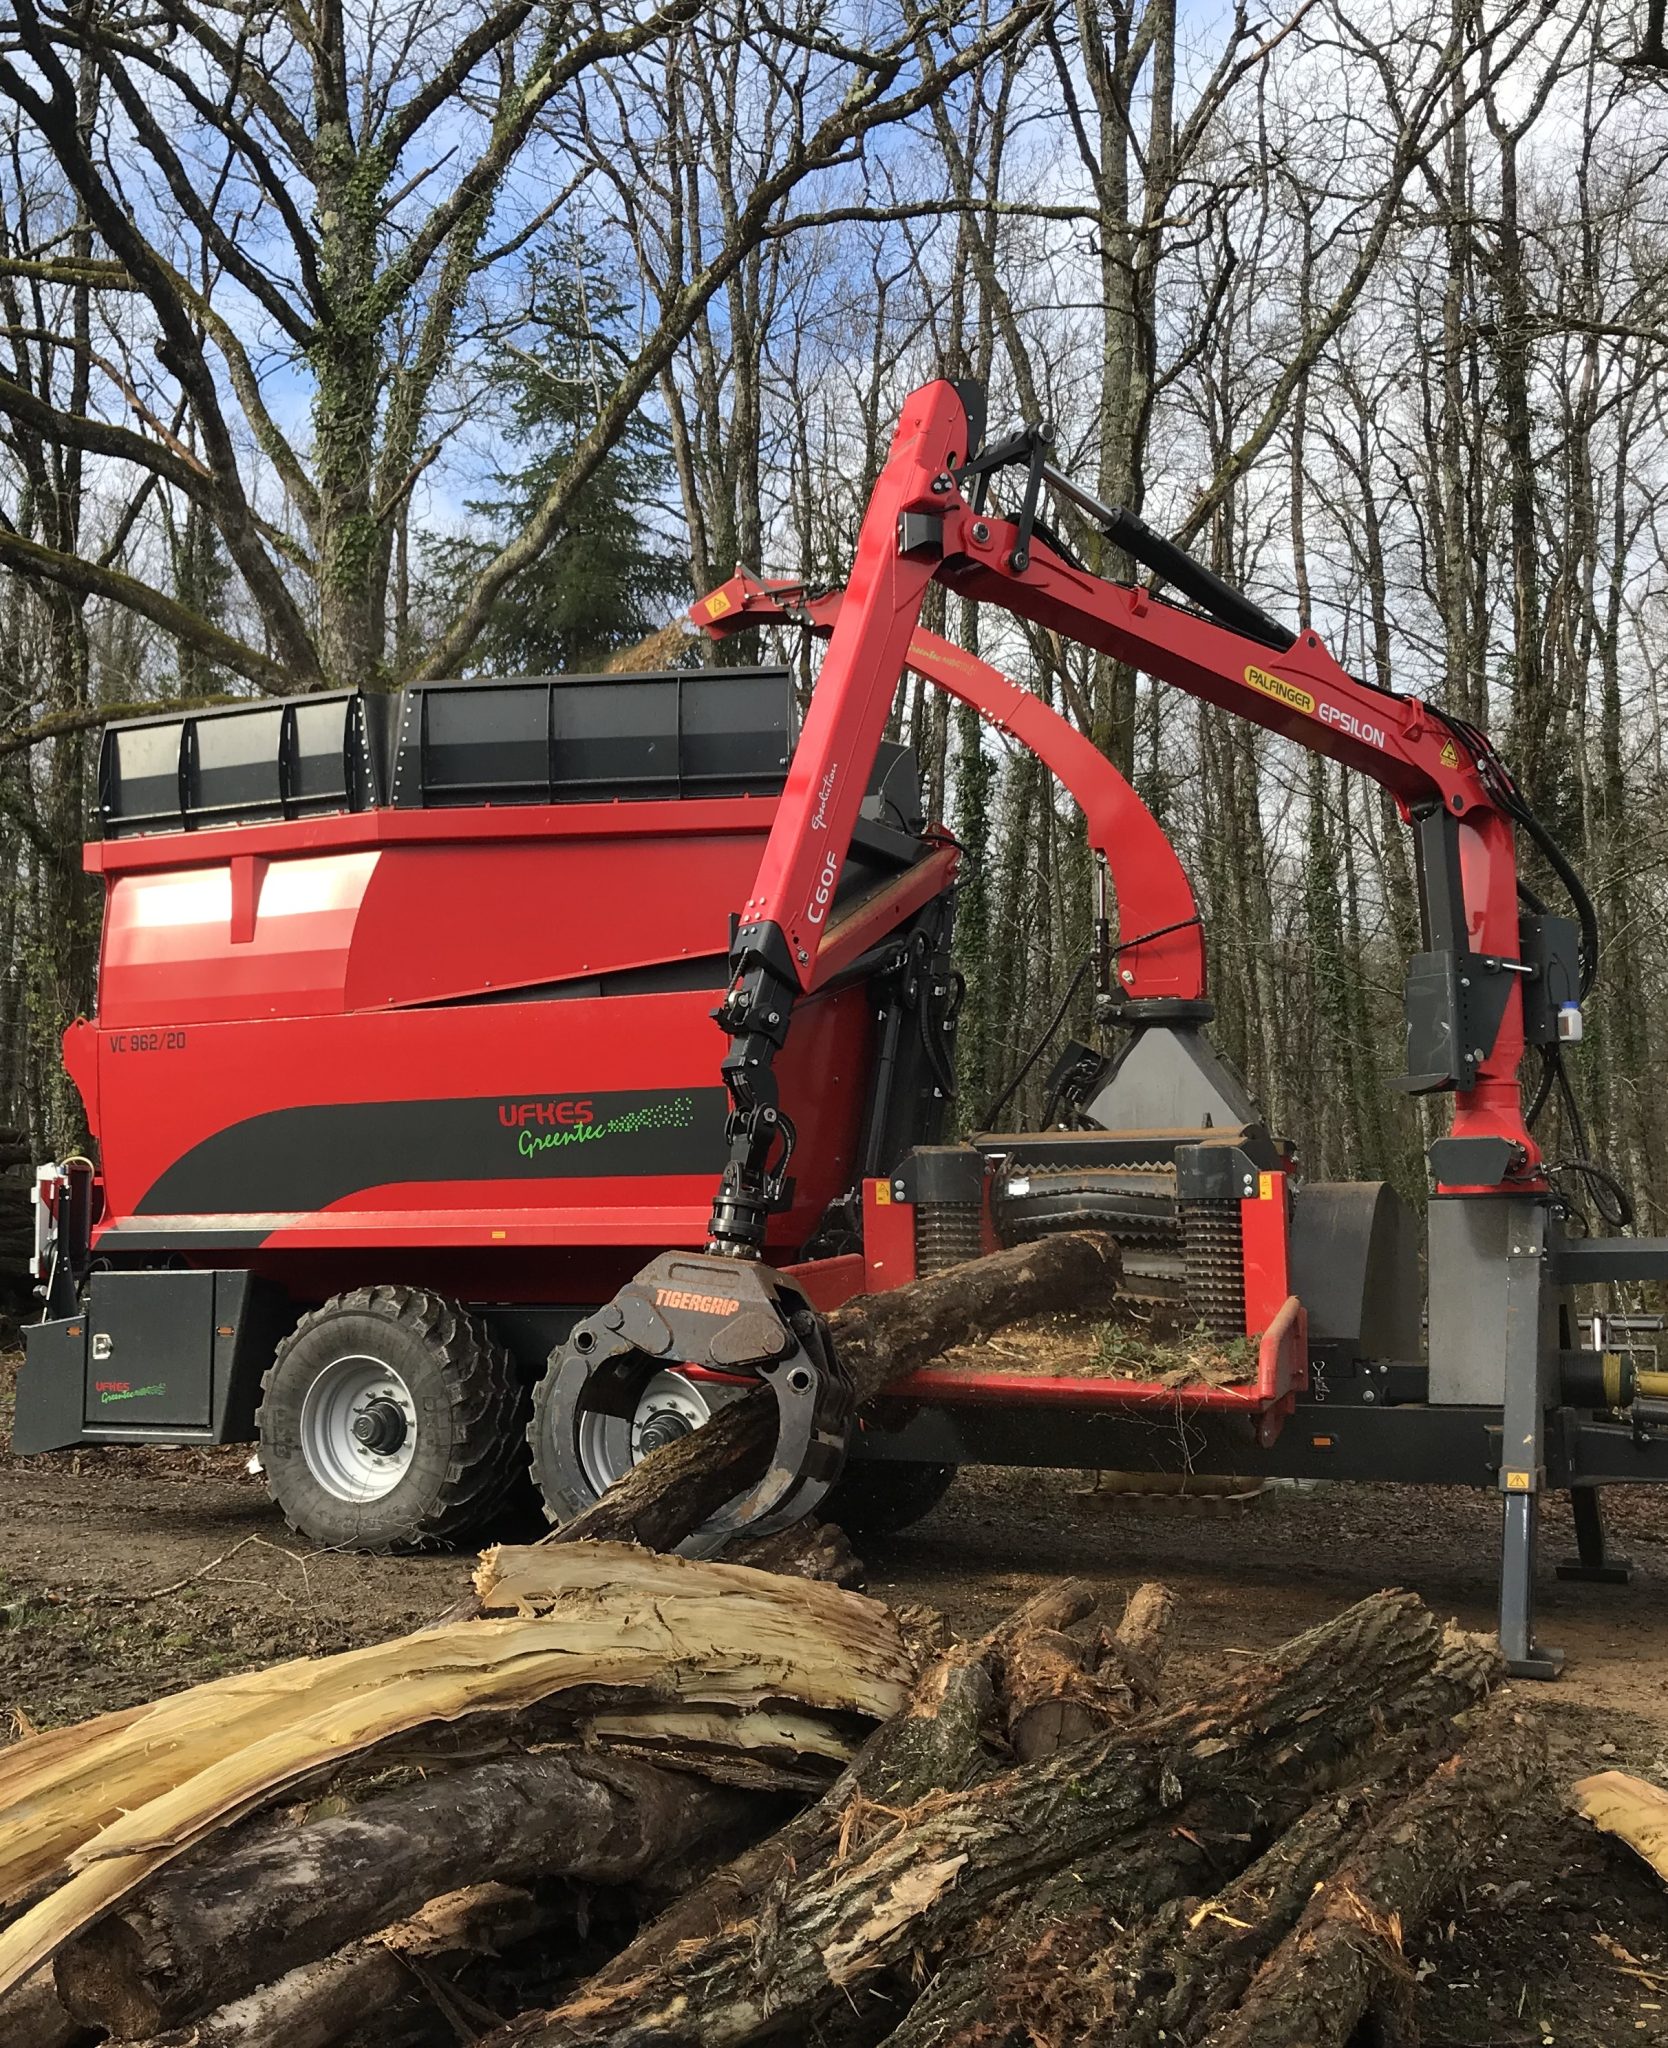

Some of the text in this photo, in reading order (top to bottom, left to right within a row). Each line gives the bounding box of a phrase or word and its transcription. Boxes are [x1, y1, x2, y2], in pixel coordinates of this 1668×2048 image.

[1249, 669, 1311, 710] PALFINGER
[1318, 703, 1385, 749] EPSILON
[811, 763, 838, 831] Epsolution
[807, 850, 838, 924] C60F
[110, 1031, 186, 1053] VC 962/20
[498, 1100, 594, 1127] UFKES
[518, 1120, 607, 1159] Greentec
[655, 1288, 740, 1317] TIGERGRIP
